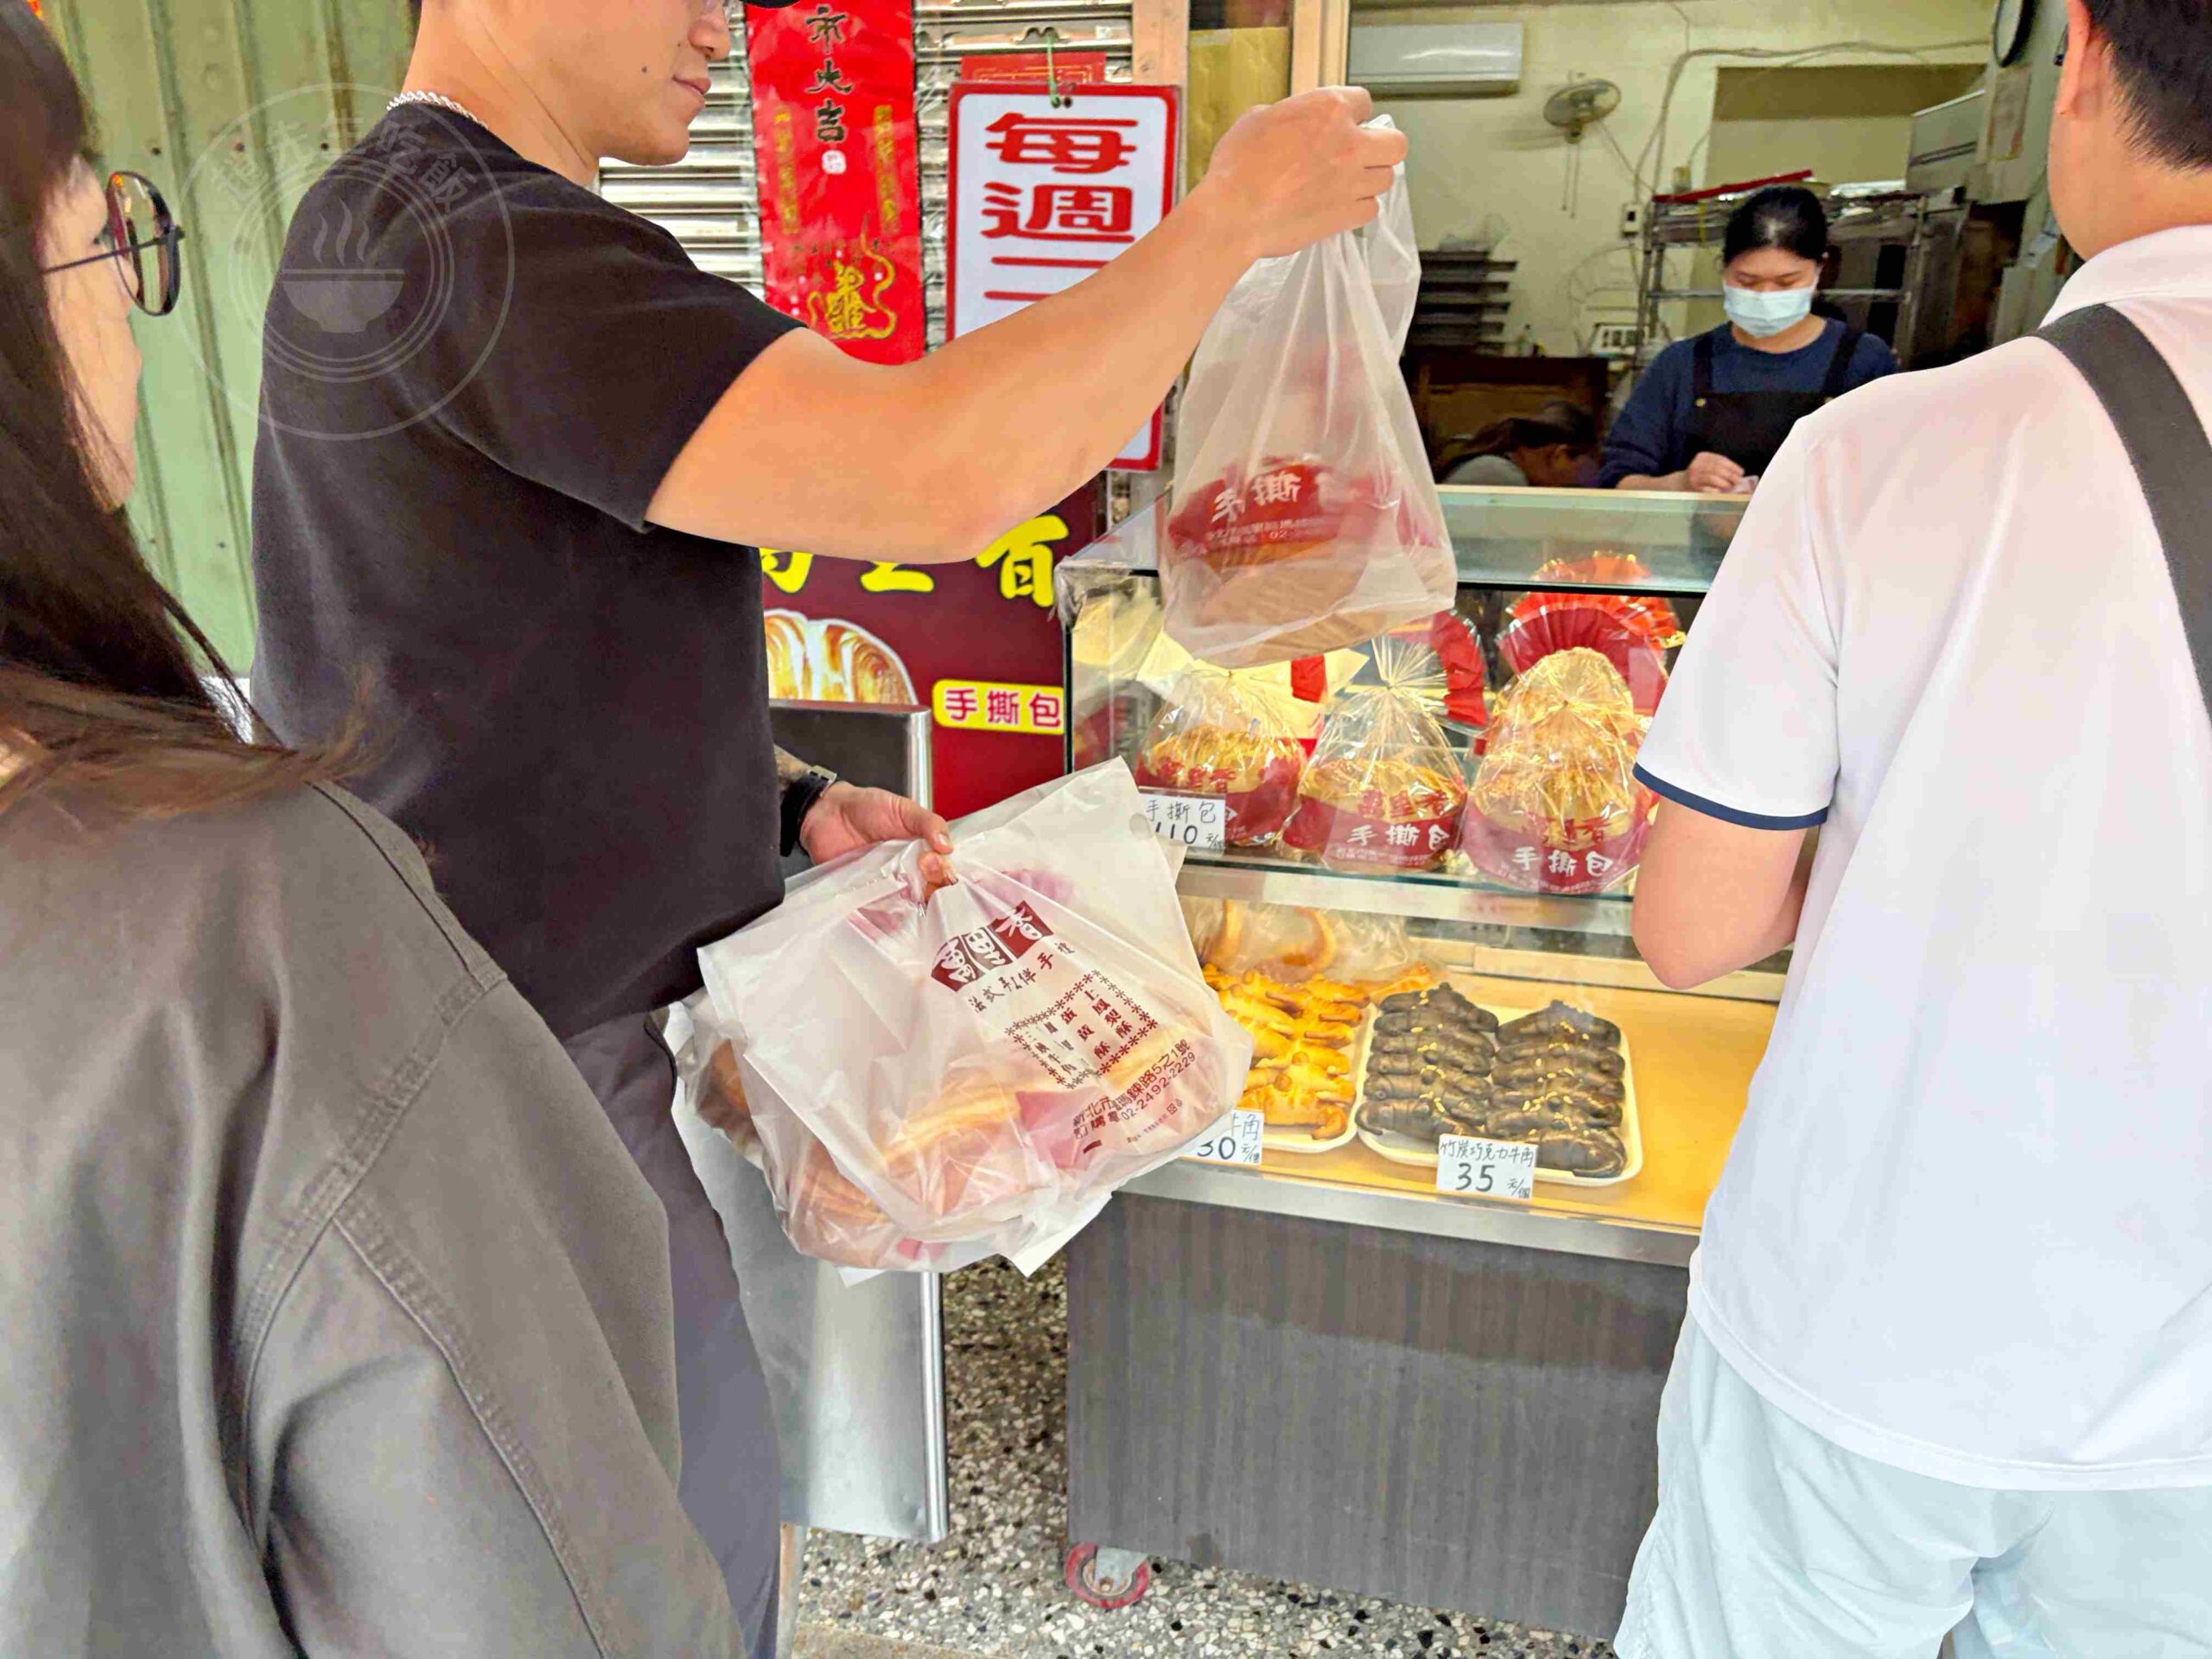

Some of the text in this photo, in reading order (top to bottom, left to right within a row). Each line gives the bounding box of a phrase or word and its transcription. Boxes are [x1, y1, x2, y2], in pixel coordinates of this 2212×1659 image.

[944, 688, 1061, 728] 手撕包
[1146, 798, 1216, 823] 手撕包
[1511, 845, 1613, 877] 手撕包
[1440, 1139, 1535, 1167] 竹炭巧克力牛角
[1456, 1162, 1495, 1192] 35
